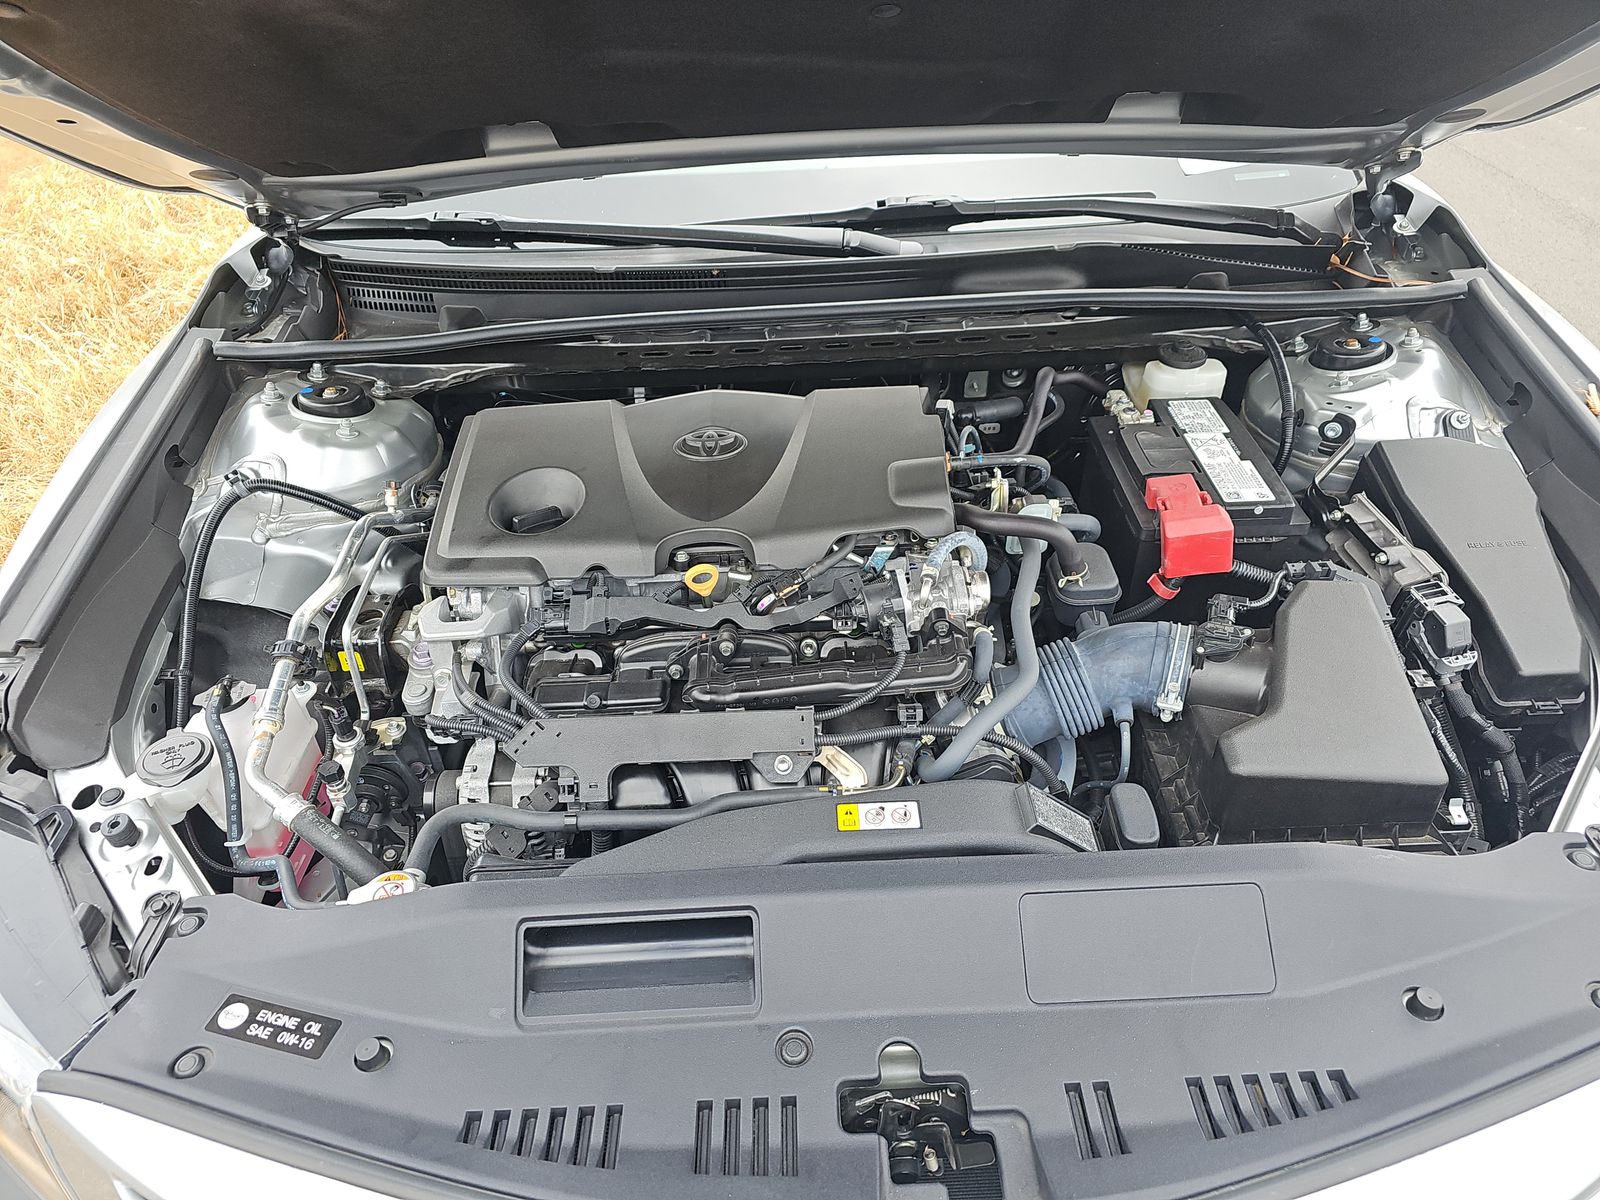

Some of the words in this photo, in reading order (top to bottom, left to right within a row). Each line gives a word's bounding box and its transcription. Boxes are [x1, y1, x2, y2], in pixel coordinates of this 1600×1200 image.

[1466, 541, 1495, 549] RELAY
[255, 1009, 301, 1030] ENGINE
[303, 1021, 321, 1036] OIL
[246, 1023, 274, 1040] SAE
[276, 1031, 315, 1050] 0W-16
